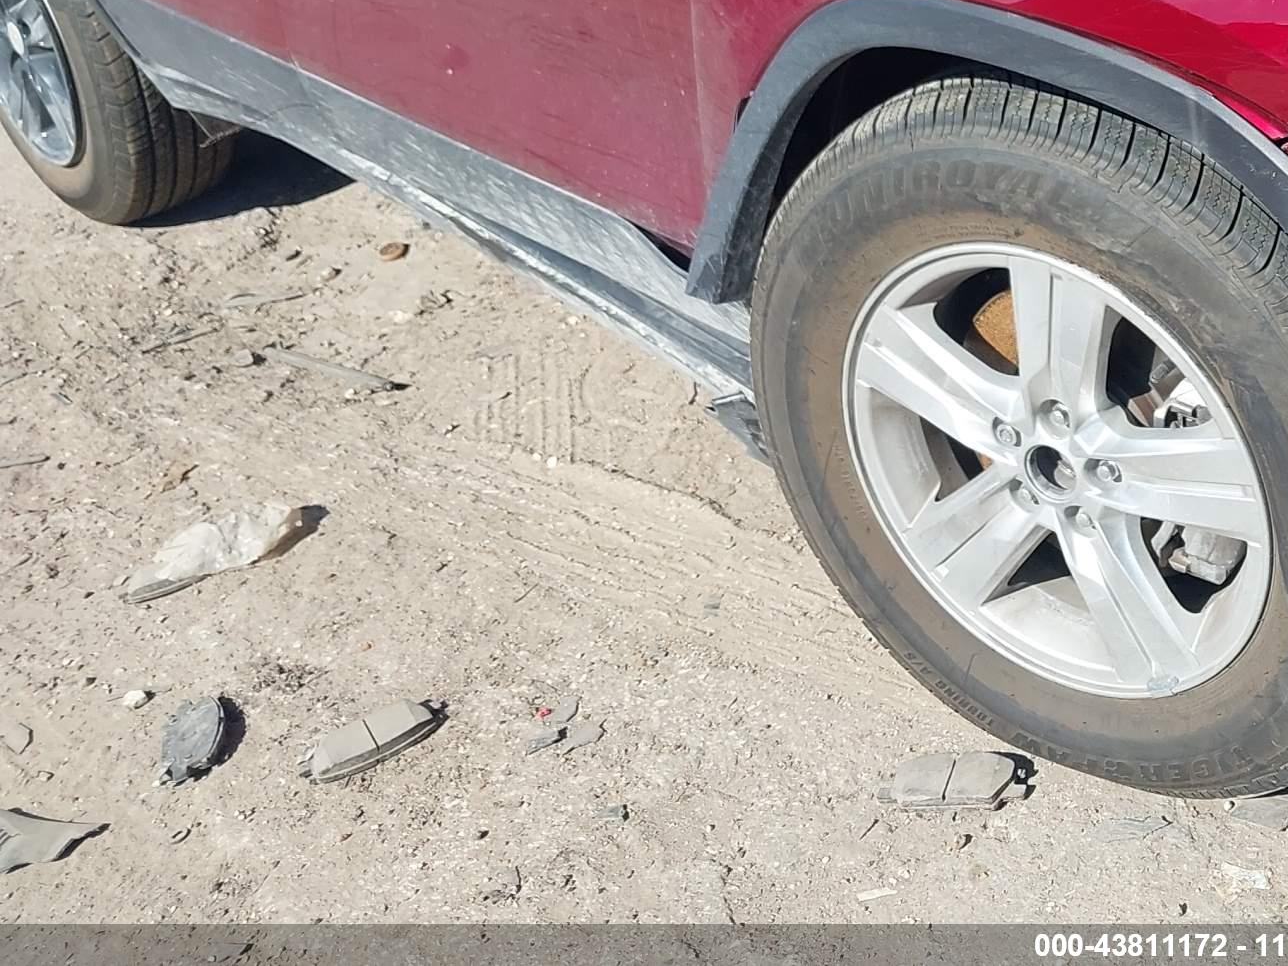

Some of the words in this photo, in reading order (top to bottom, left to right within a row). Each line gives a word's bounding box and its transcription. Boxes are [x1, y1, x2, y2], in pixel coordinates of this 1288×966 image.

[826, 158, 1080, 224] UNIROYAL
[935, 679, 995, 727] TOURING
[1138, 744, 1254, 784] TIGER
